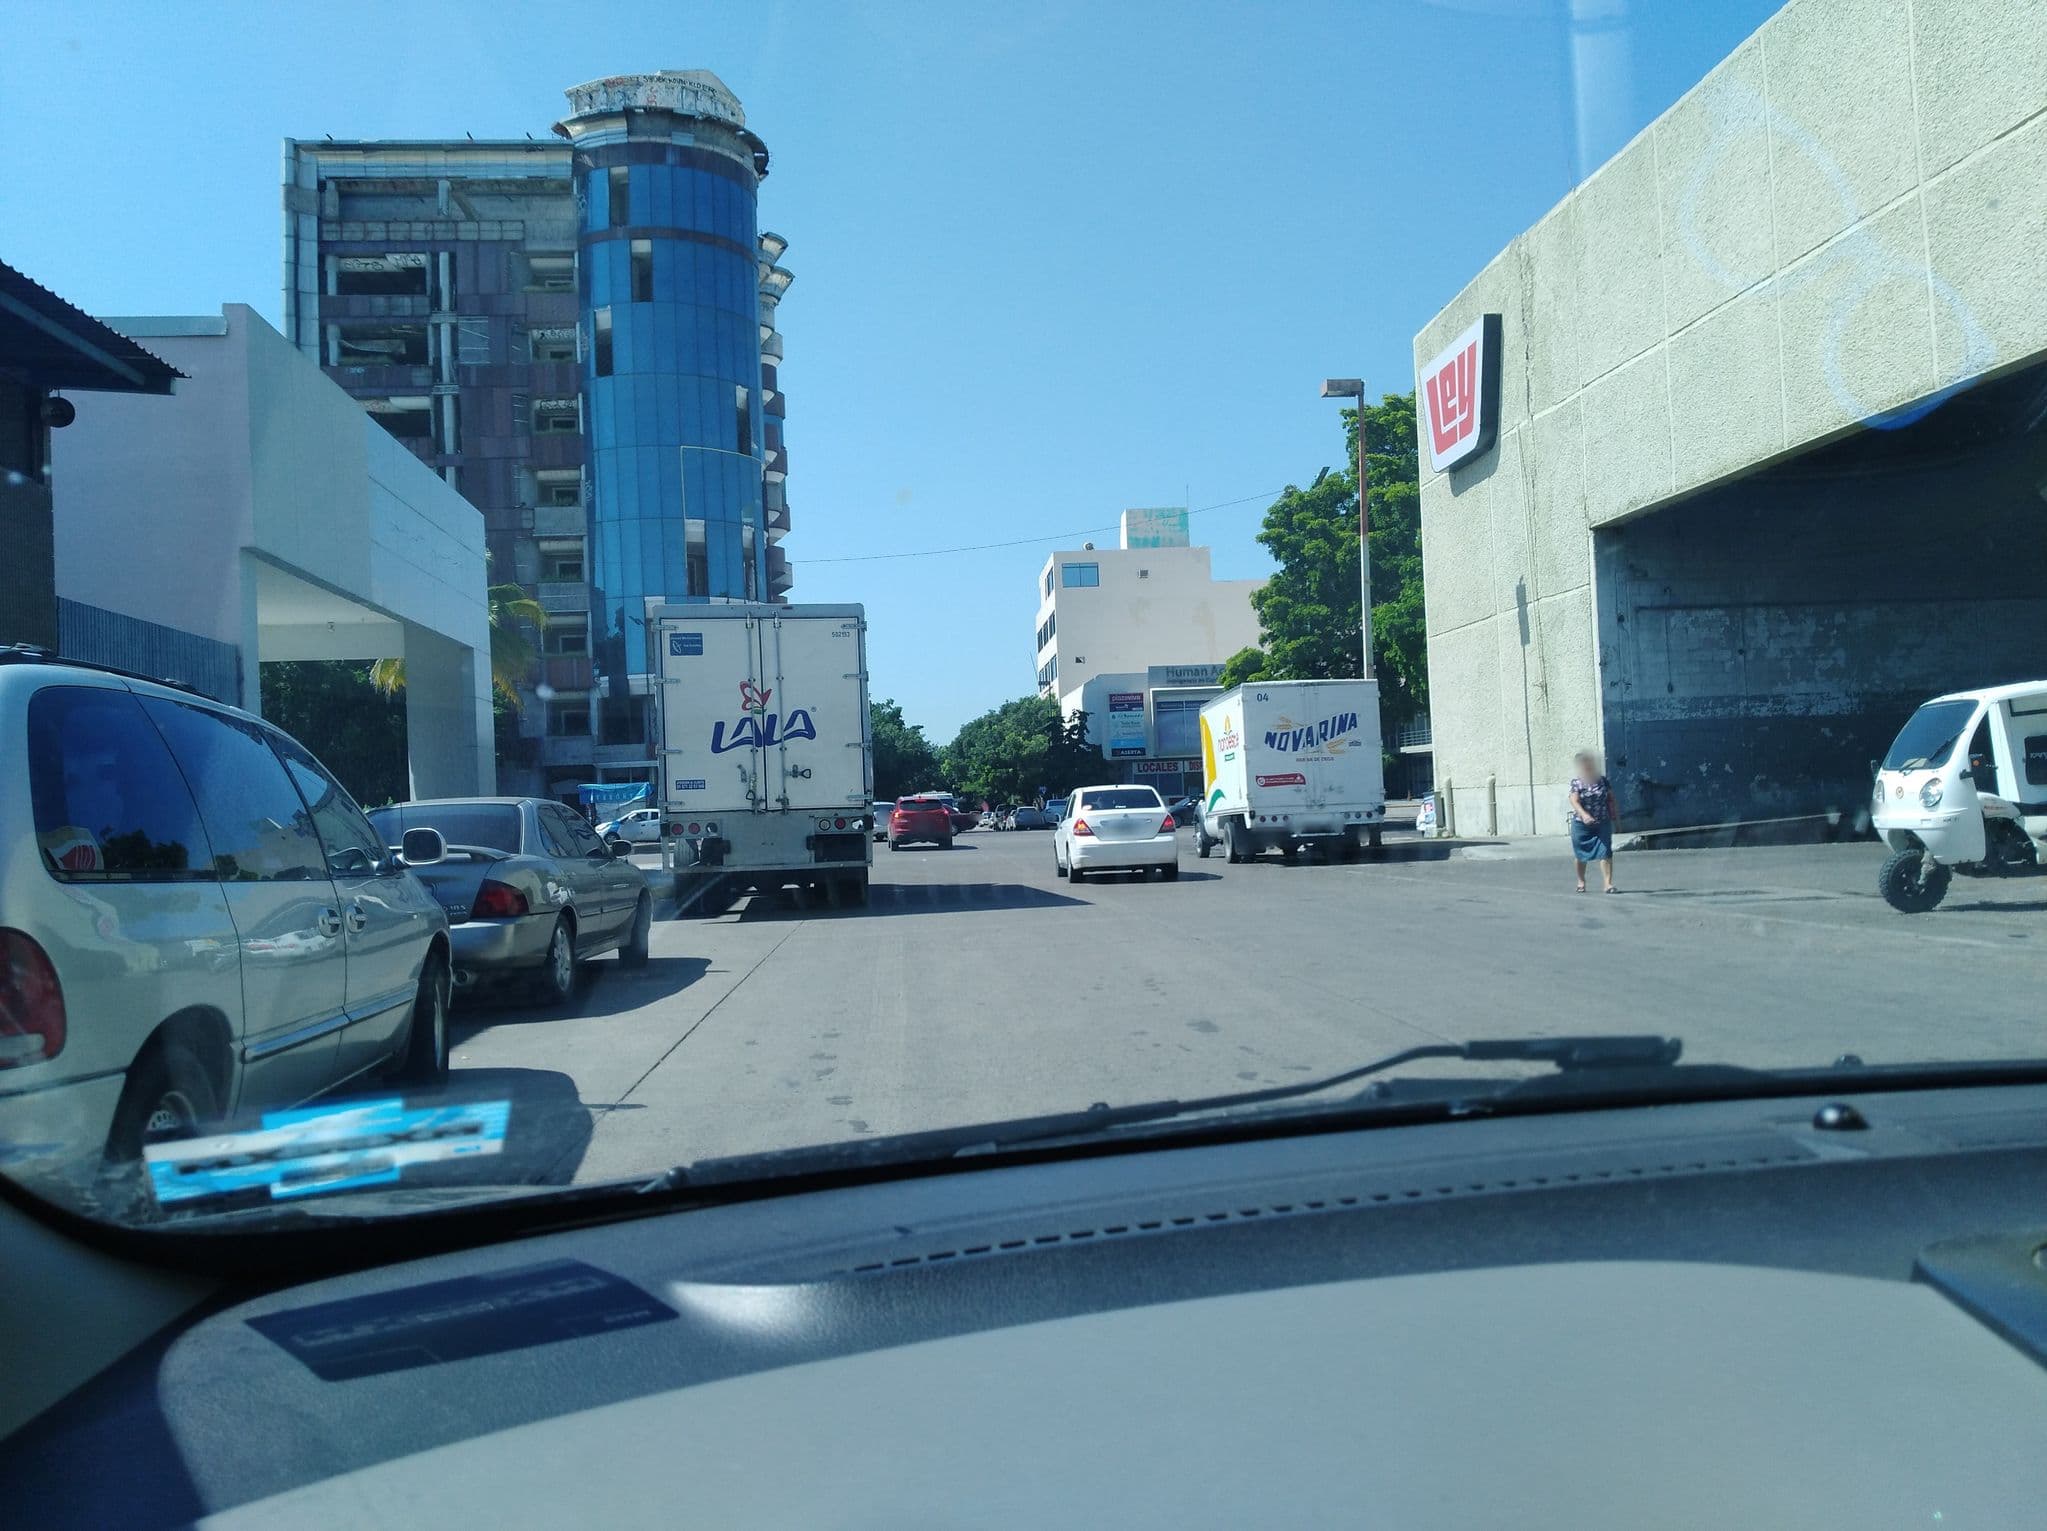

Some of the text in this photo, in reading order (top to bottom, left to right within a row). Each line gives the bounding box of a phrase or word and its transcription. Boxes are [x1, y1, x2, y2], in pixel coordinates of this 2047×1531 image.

[1426, 340, 1478, 455] Ley
[1166, 666, 1208, 678] Human
[1256, 693, 1269, 702] 04
[710, 709, 816, 754] LALA
[1264, 712, 1358, 752] NOVARINA
[1137, 761, 1179, 773] LOCALES
